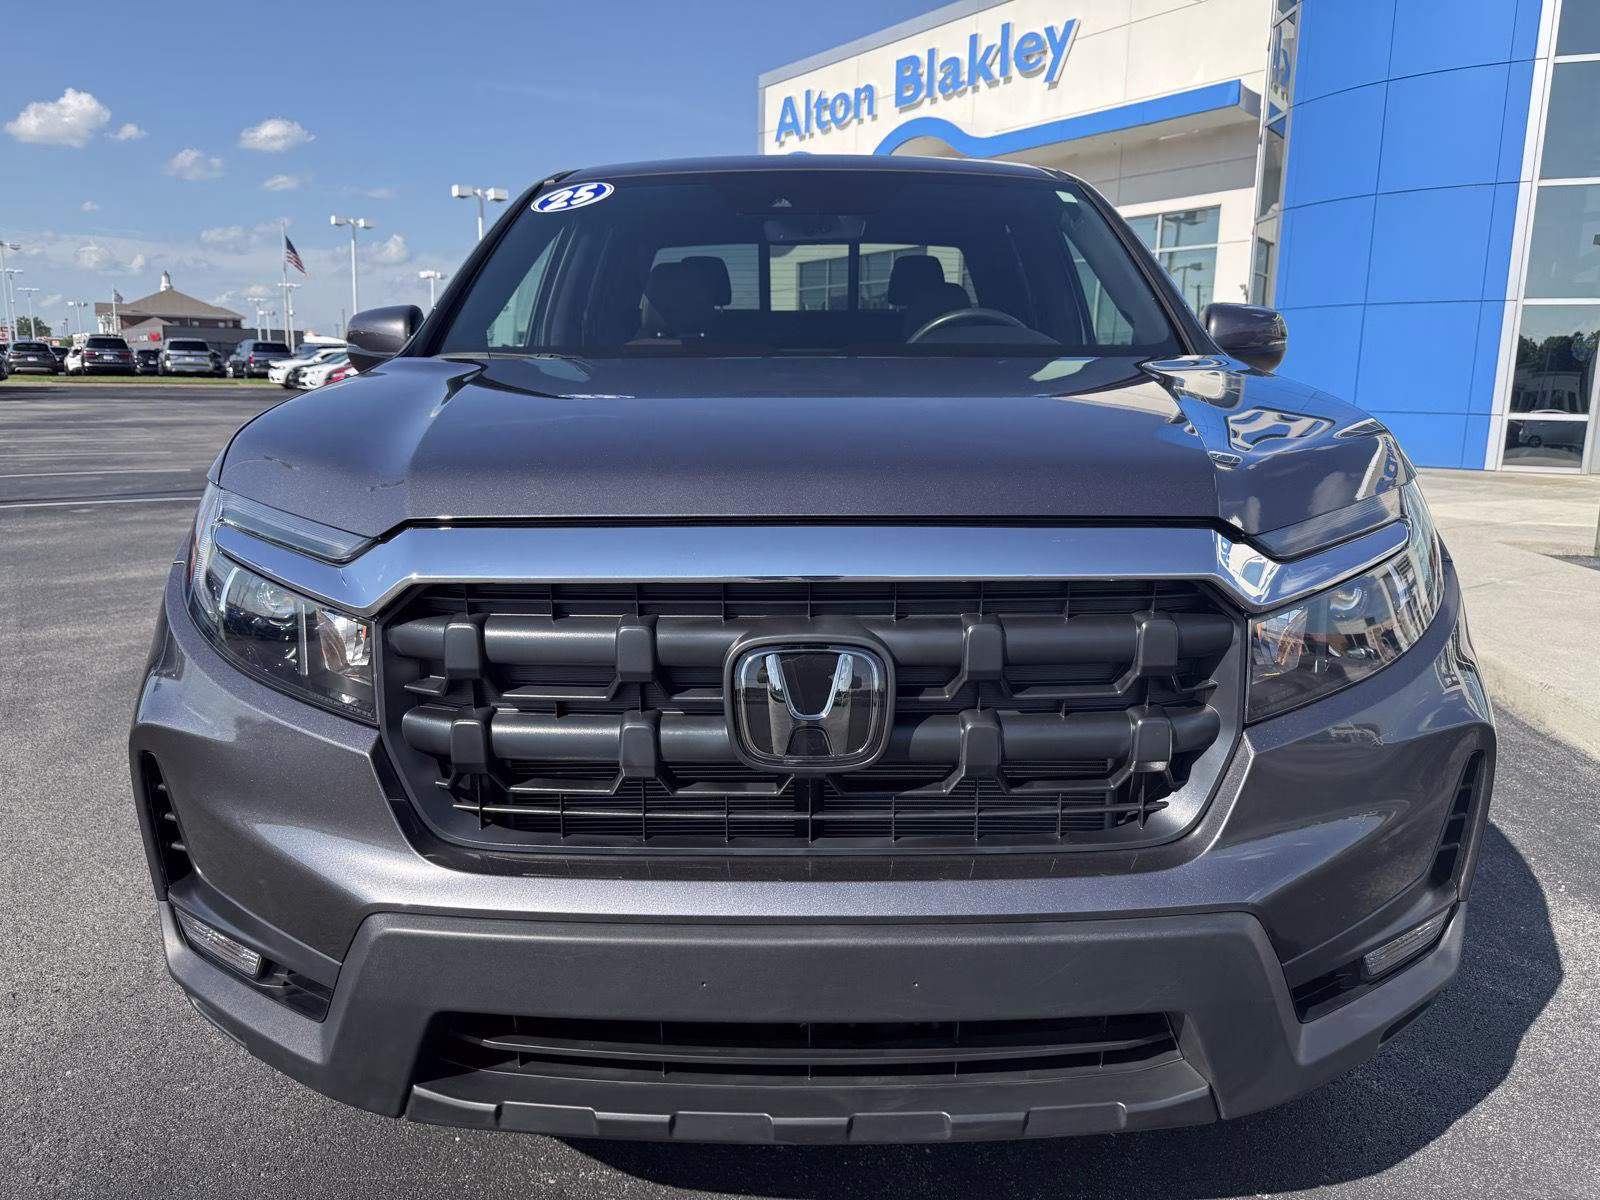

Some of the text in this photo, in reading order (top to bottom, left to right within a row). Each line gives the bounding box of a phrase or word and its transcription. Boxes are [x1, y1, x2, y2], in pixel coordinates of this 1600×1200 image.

[775, 18, 1079, 142] Alton Blakley
[543, 183, 598, 212] 25
